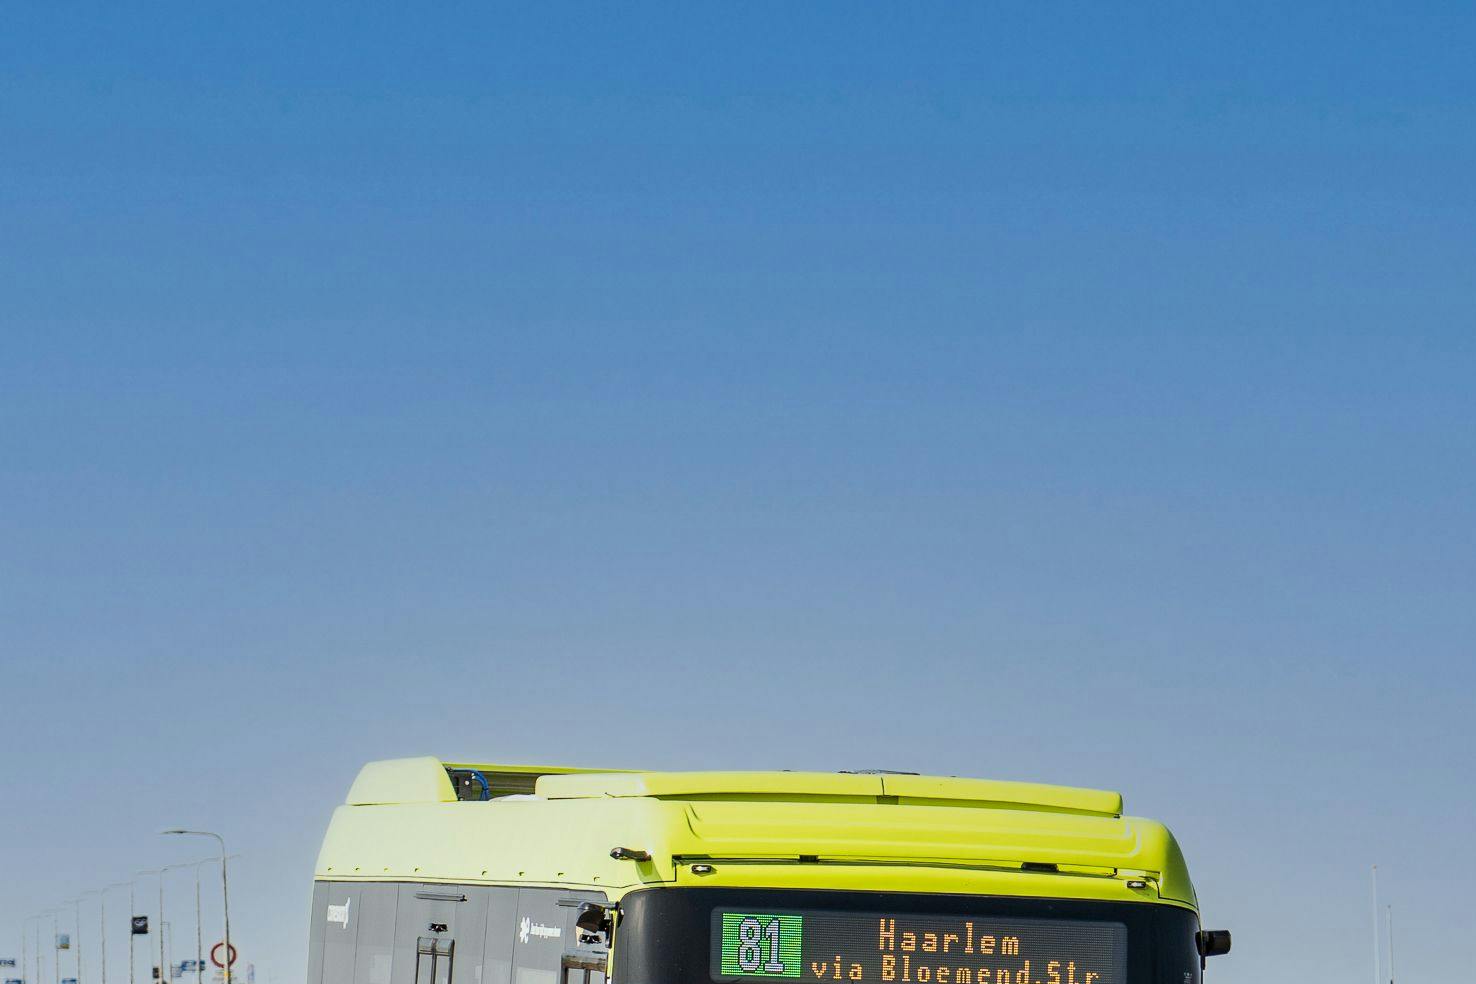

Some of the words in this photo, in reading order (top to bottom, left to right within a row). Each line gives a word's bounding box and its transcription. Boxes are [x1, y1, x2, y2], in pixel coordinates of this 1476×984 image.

[739, 917, 785, 973] 81
[879, 918, 1020, 956] Haarlem
[810, 955, 863, 981] via
